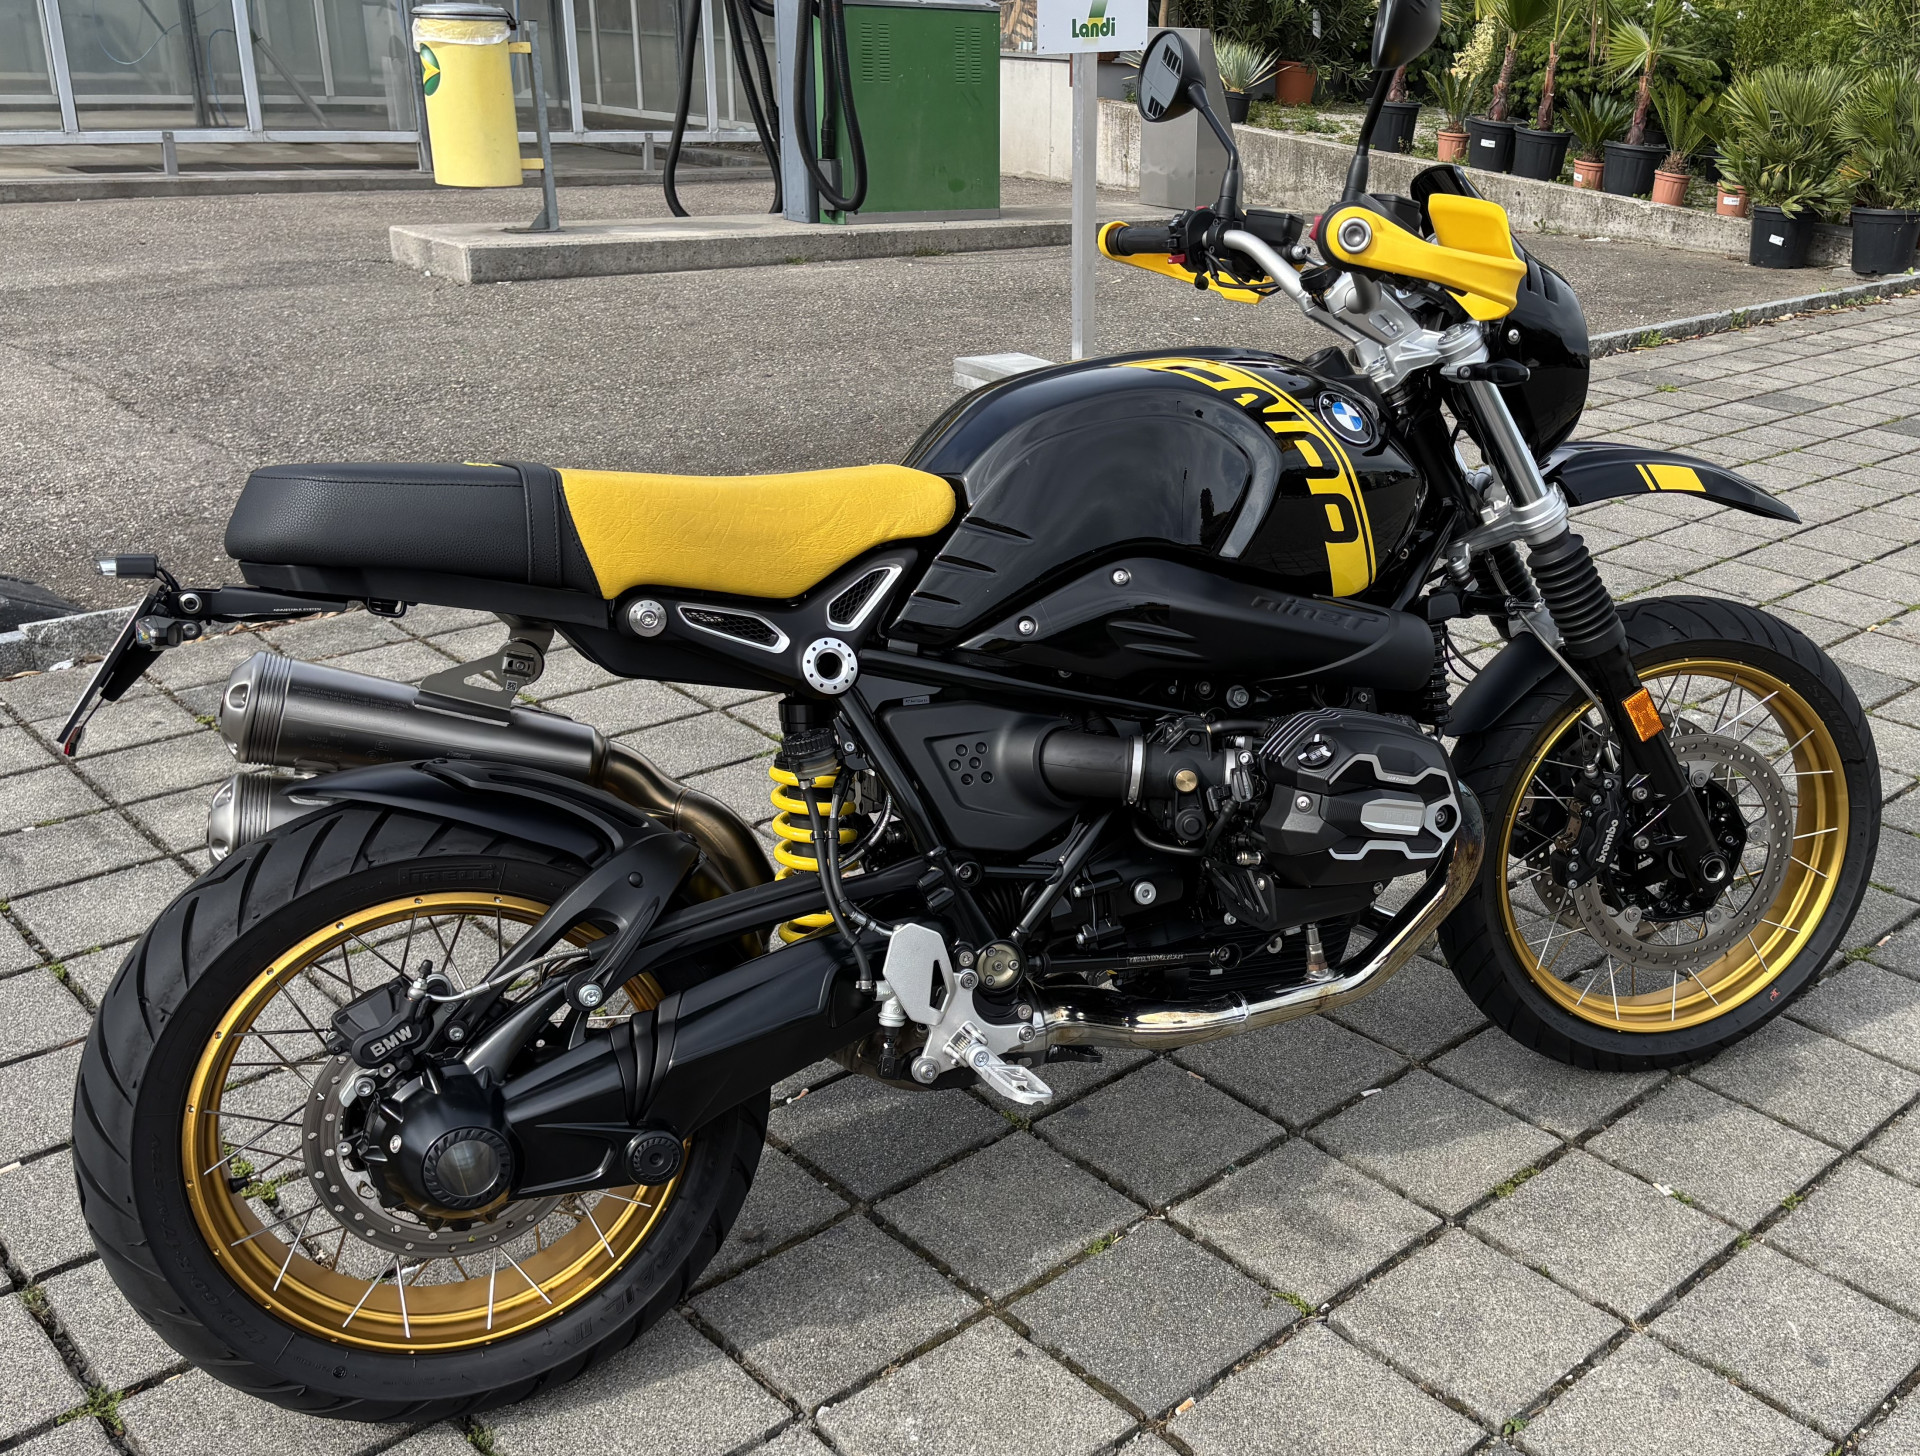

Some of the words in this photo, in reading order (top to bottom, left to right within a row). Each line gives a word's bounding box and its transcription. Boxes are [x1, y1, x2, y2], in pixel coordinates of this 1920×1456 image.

[1072, 17, 1116, 38] Landi
[1595, 819, 1619, 864] brembo
[369, 1025, 413, 1058] BMW
